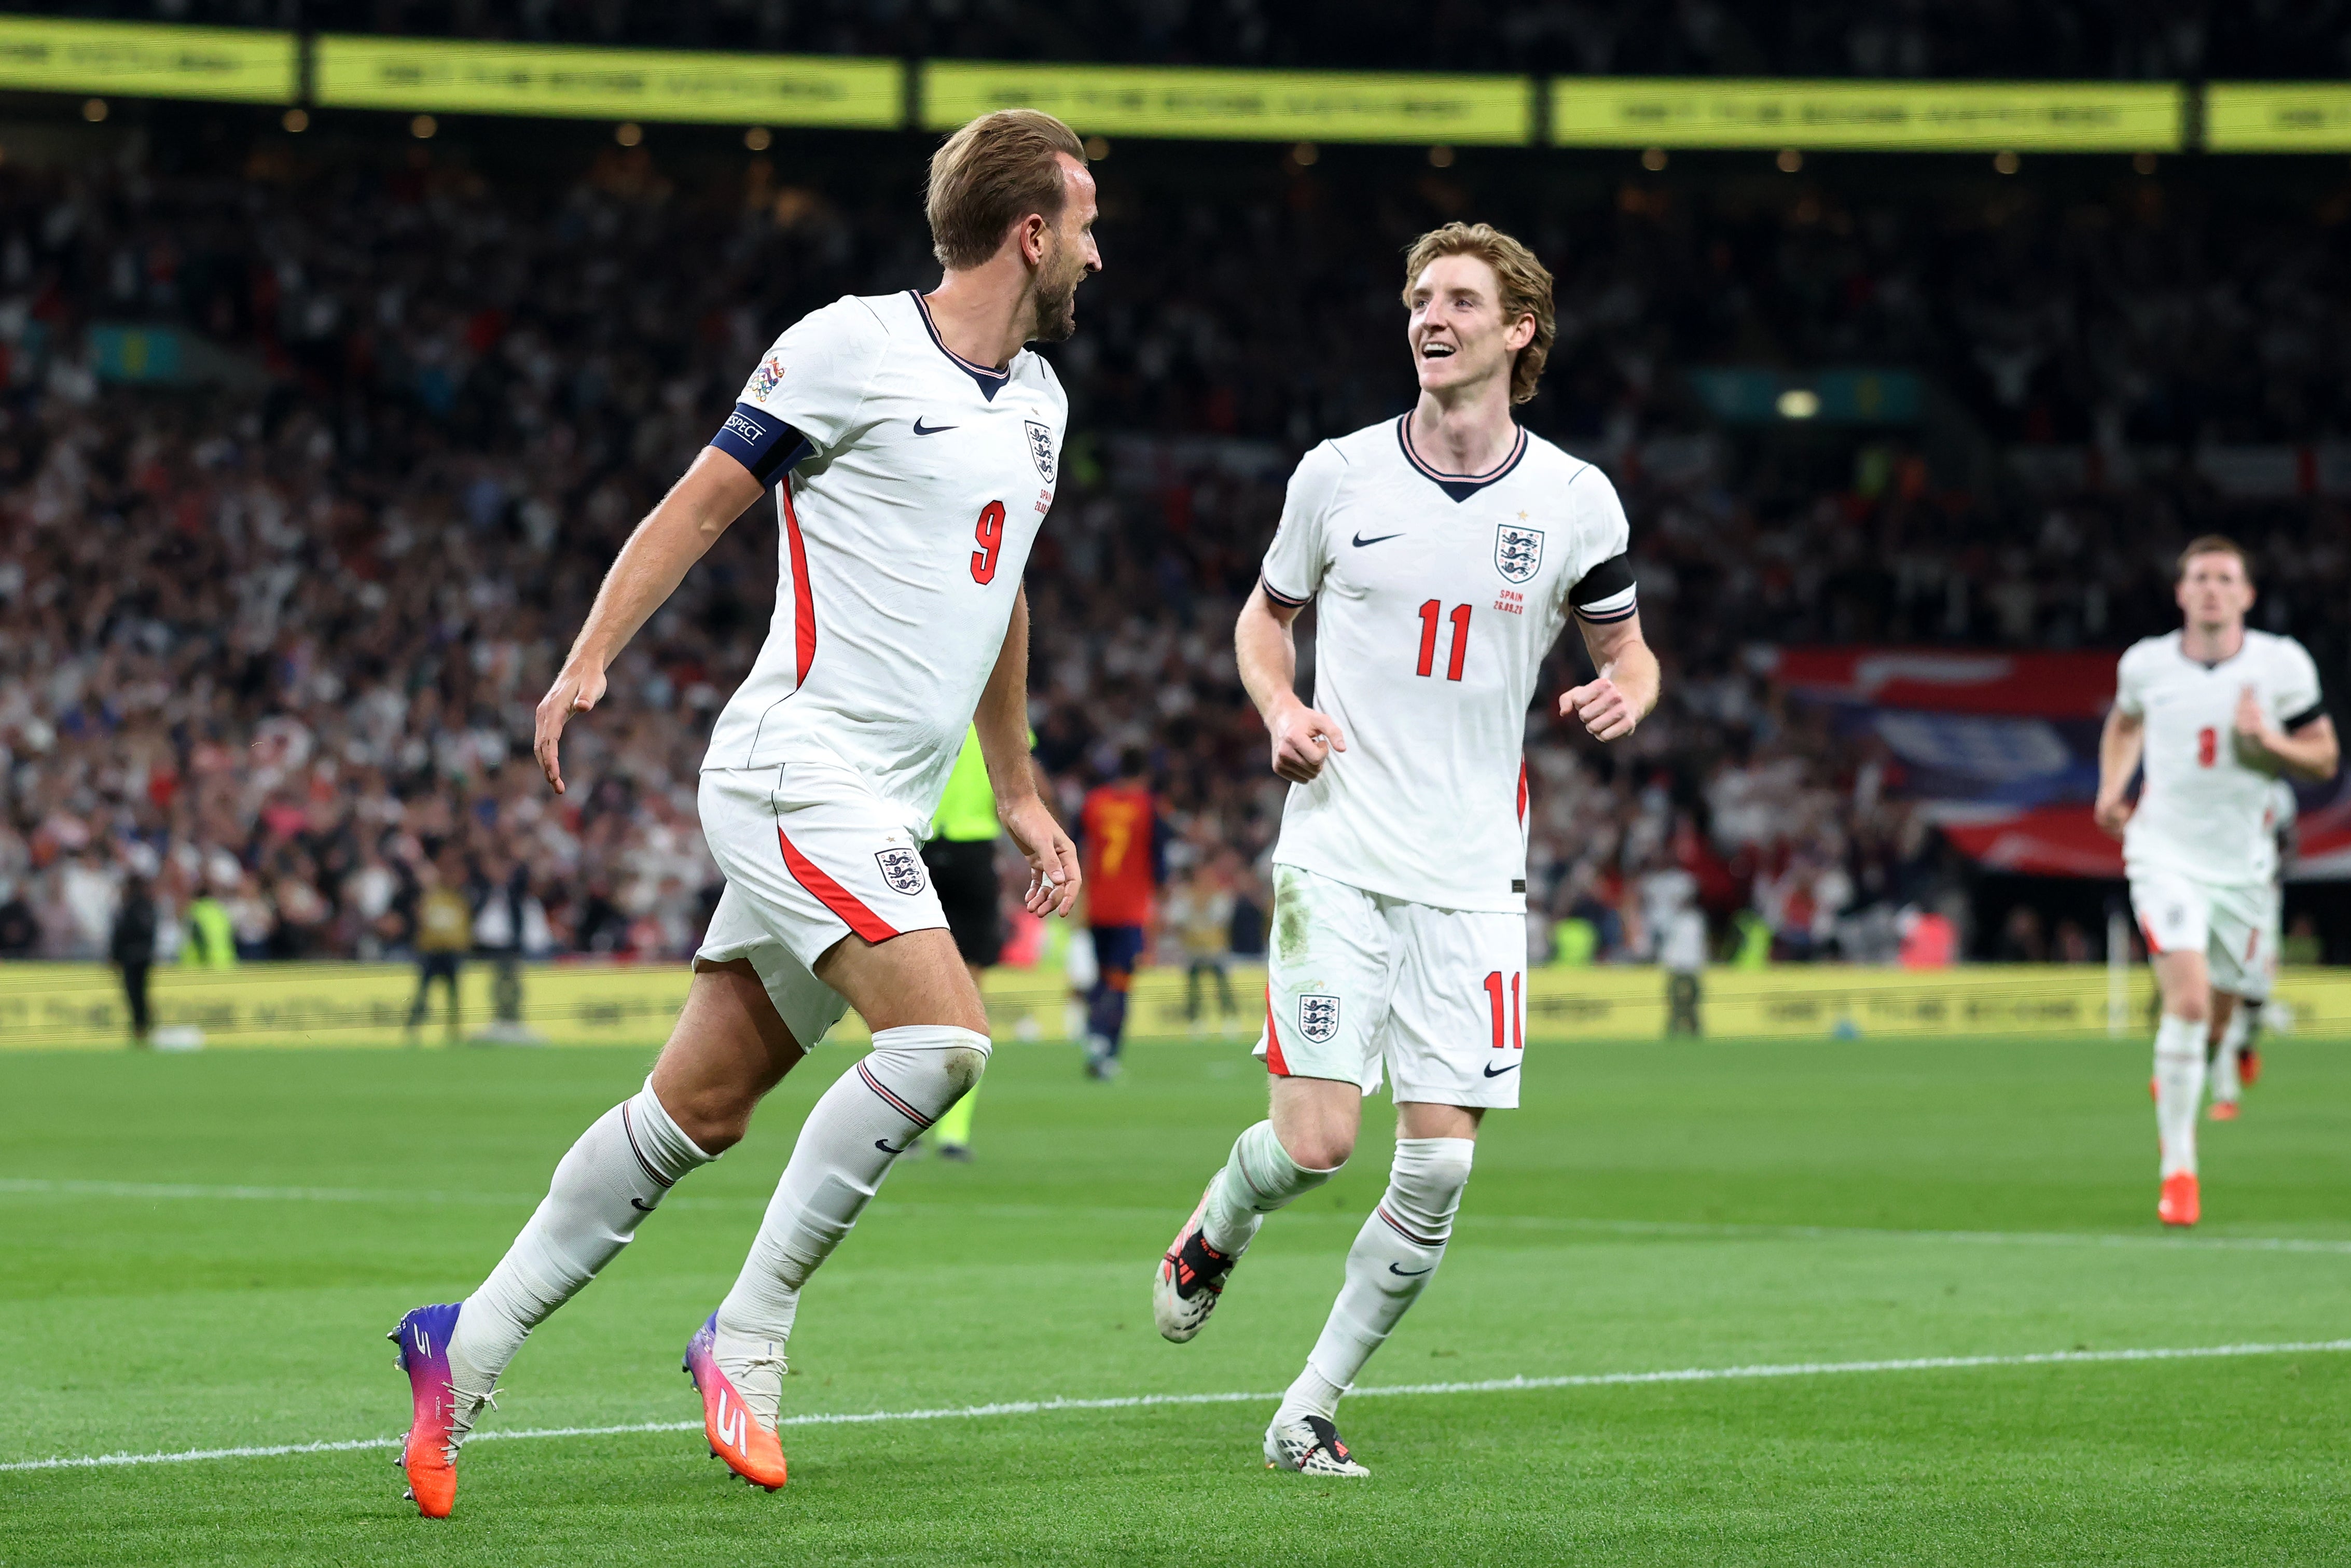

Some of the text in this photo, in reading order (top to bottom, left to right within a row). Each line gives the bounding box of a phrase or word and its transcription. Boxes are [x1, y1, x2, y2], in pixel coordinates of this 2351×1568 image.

[724, 415, 763, 440] ESPECT
[1040, 489, 1052, 502] SPAIN
[970, 499, 1006, 586] 9
[1500, 590, 1523, 602] SPAIN
[1416, 599, 1472, 682] 11
[1484, 971, 1523, 1049] 11
